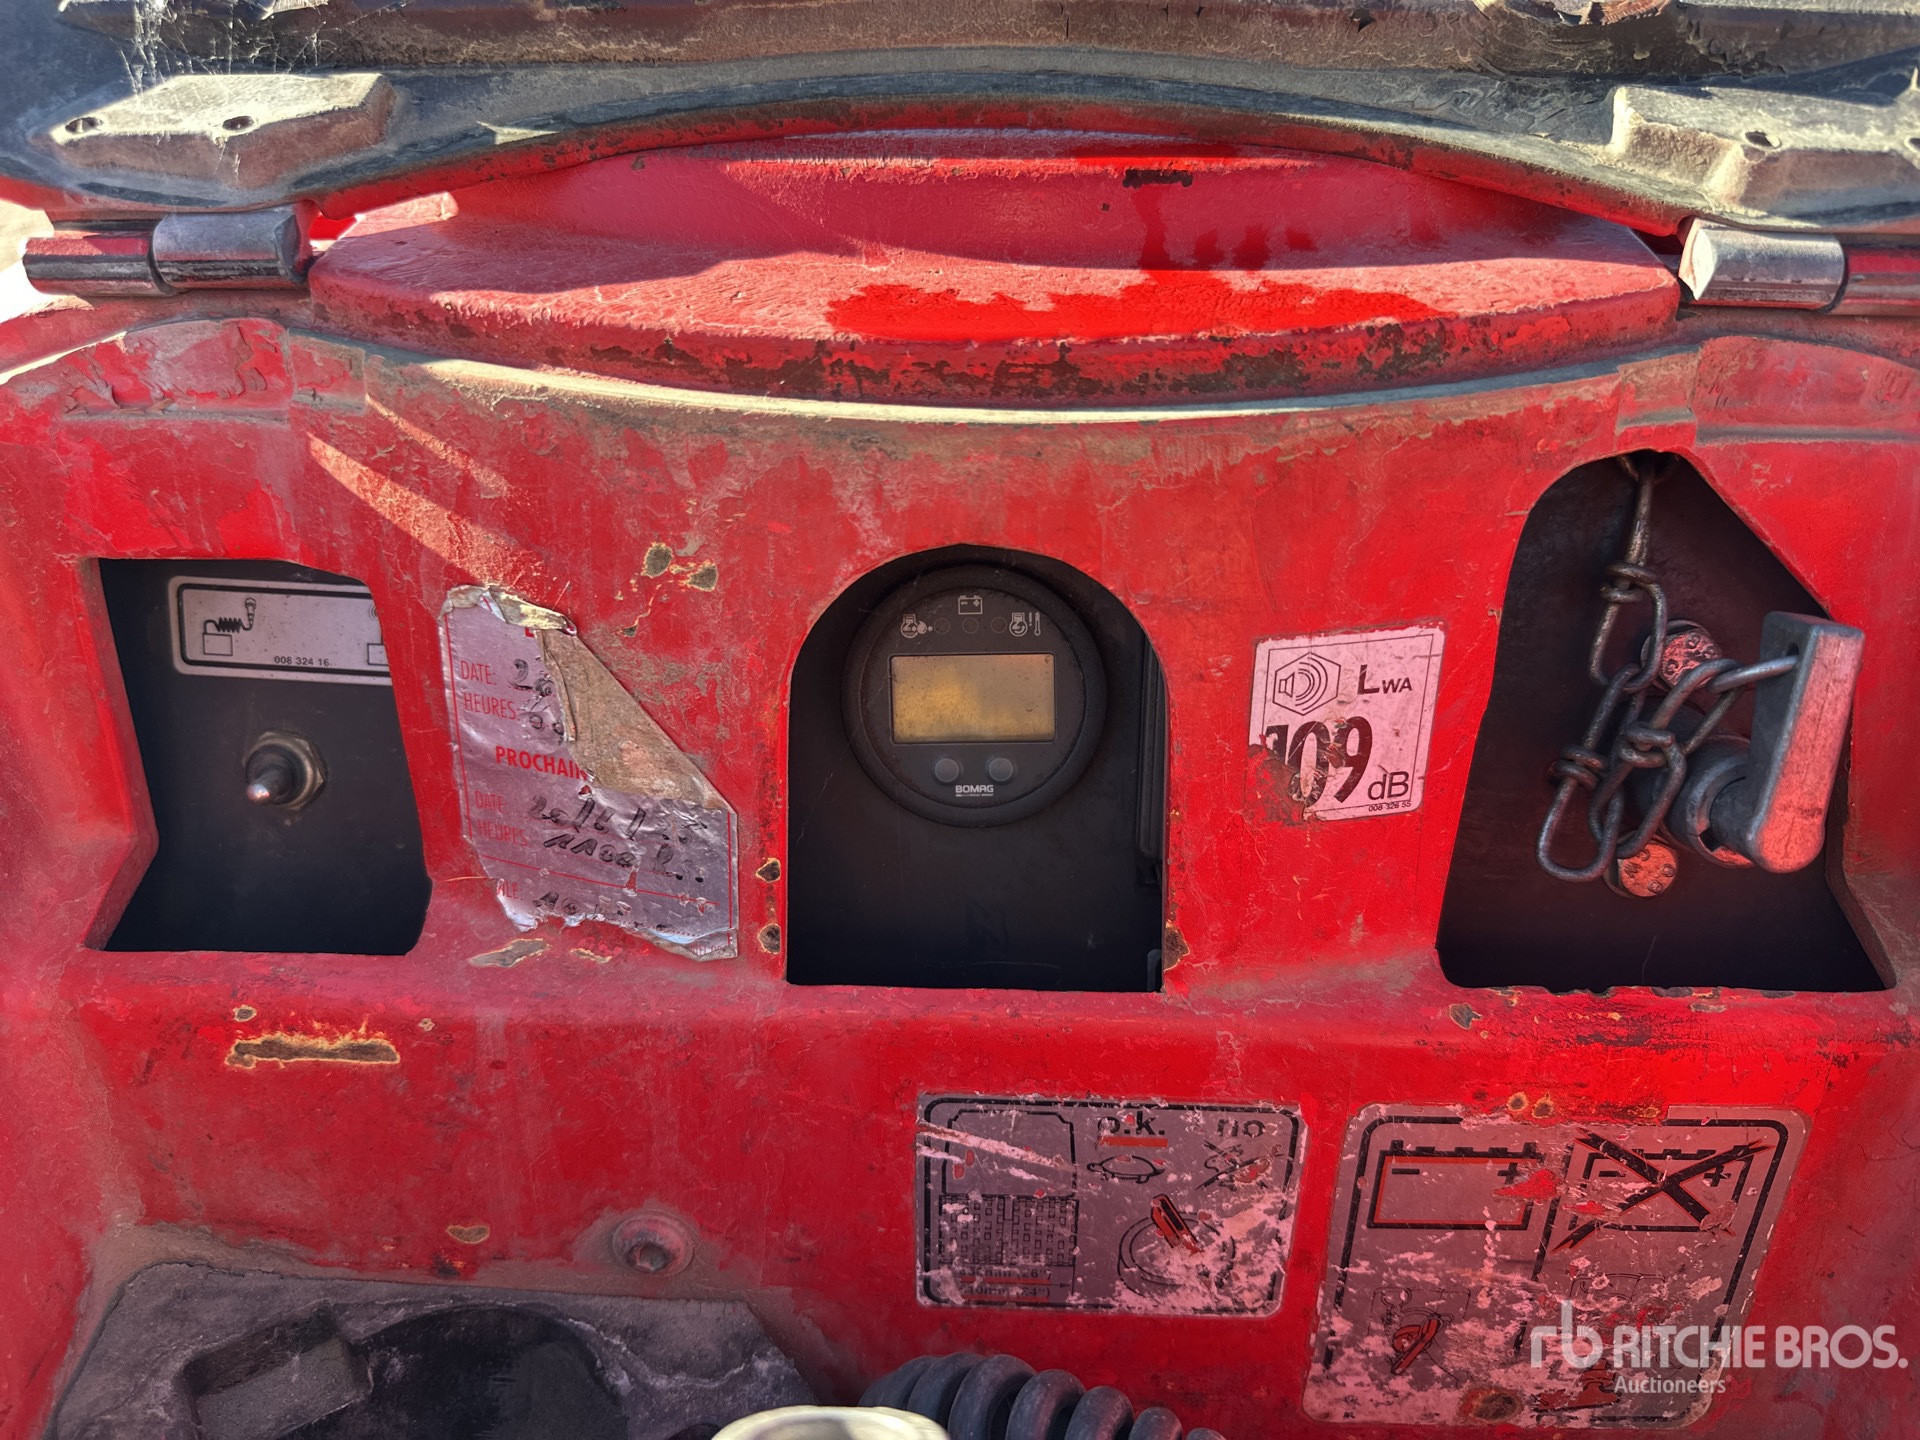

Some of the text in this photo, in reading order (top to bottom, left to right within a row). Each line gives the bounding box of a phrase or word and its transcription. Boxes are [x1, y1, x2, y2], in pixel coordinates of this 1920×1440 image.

[274, 656, 330, 667] 008 324 16
[460, 660, 497, 686] DATE:
[463, 692, 521, 722] HEURES:
[955, 784, 994, 793] BOMAG
[1367, 771, 1410, 801] dB
[1368, 803, 1384, 812] 008
[1217, 1119, 1266, 1138] no
